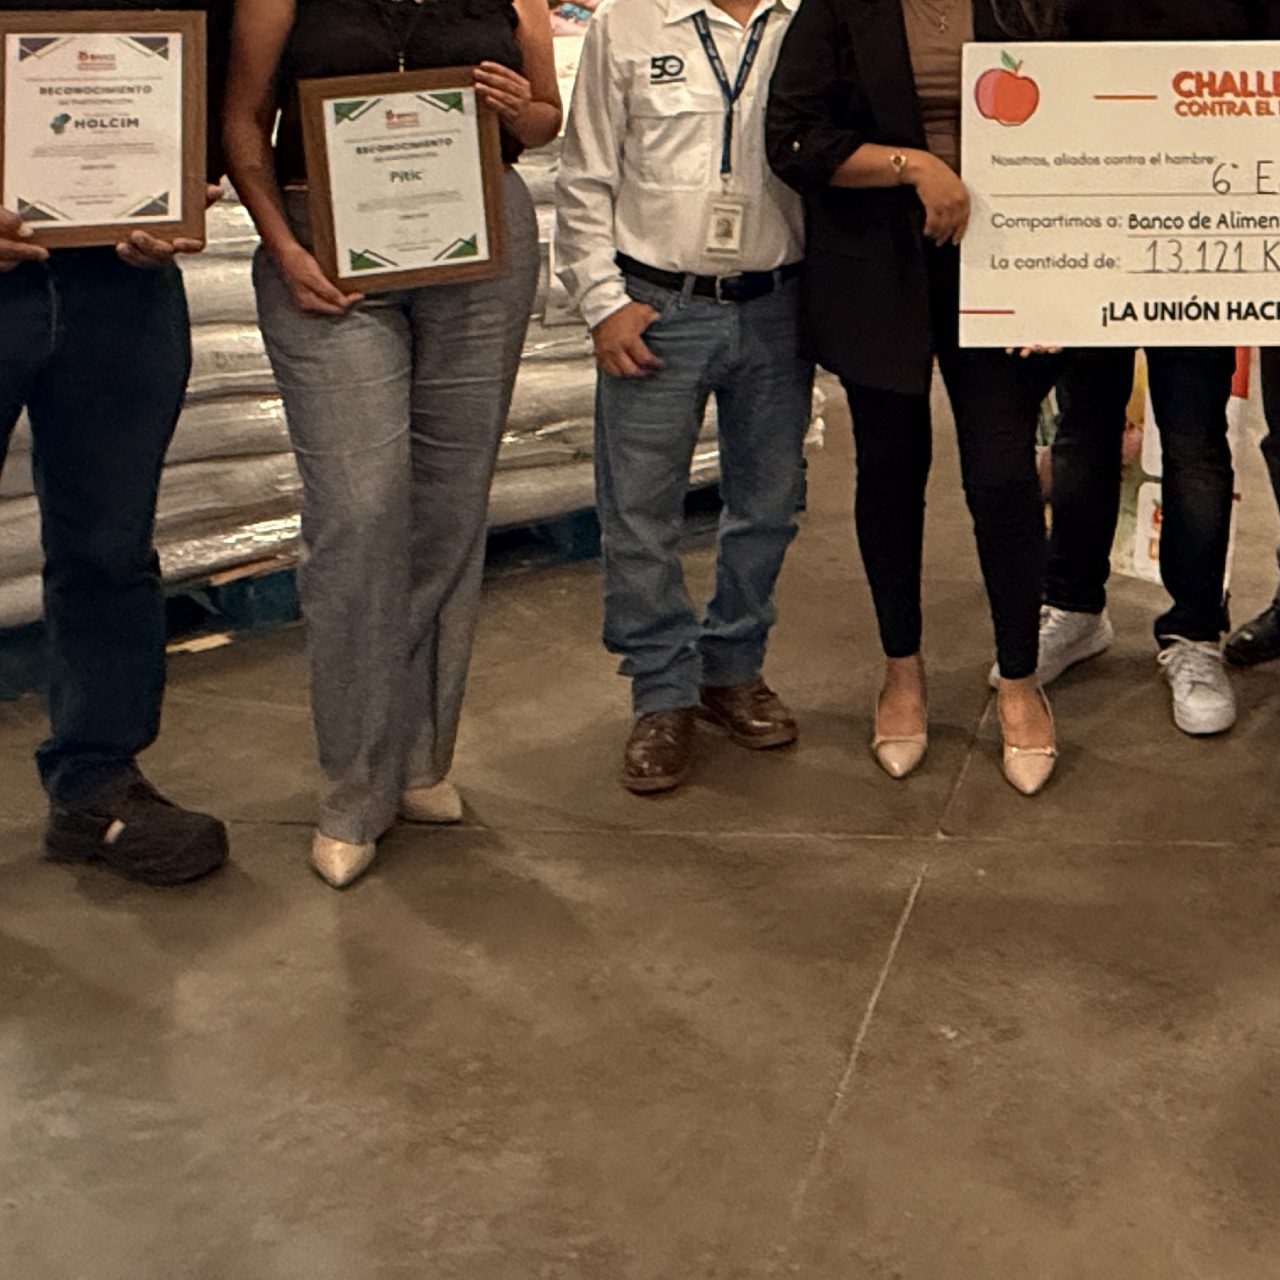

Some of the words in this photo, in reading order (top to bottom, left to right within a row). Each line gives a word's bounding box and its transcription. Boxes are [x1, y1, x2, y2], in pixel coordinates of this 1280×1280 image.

[40, 85, 153, 96] RECONOCIMIENTO
[1174, 100, 1252, 117] CONTRA
[1255, 100, 1275, 116] EL
[74, 117, 140, 129] HOLCIM
[355, 137, 453, 155] RECONOCIMIENTO
[991, 154, 1050, 167] Nosotros,
[1053, 152, 1100, 165] aliados
[1103, 155, 1146, 166] contra
[1149, 152, 1162, 165] el
[991, 213, 1102, 231] Compartimos
[1106, 216, 1122, 229] a:
[1128, 212, 1183, 229] Banco
[1188, 210, 1211, 229] de
[991, 254, 1009, 269] La
[1014, 252, 1088, 269] cantidad
[1093, 253, 1121, 269] de:
[1102, 301, 1138, 327] ¡LA
[1143, 294, 1220, 321] UNIÓN
